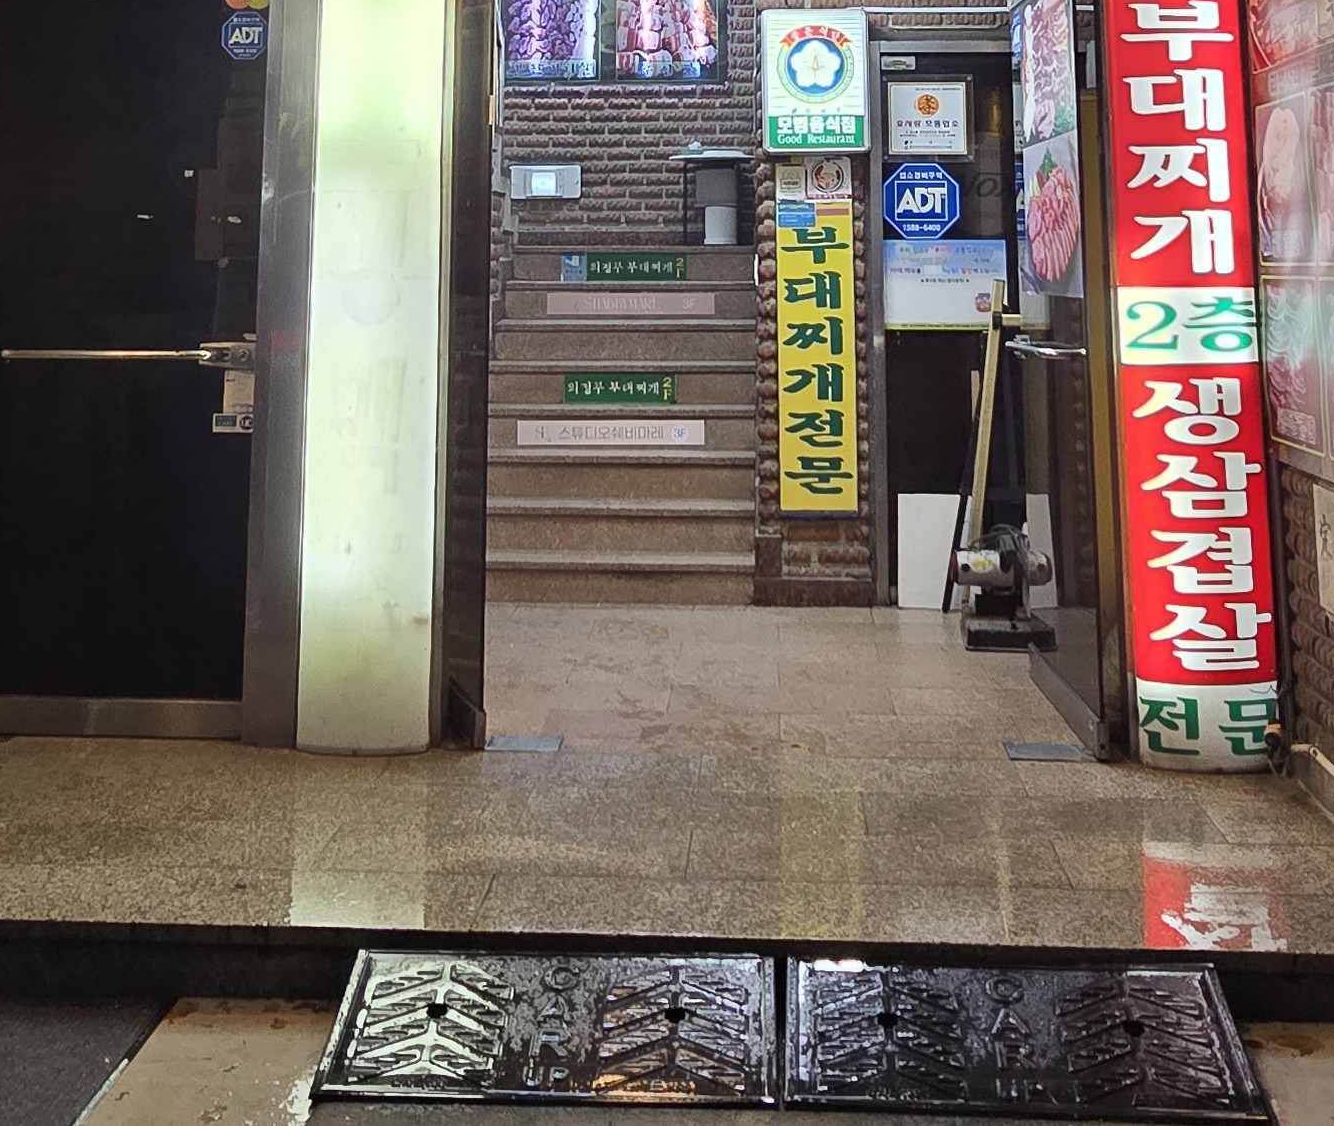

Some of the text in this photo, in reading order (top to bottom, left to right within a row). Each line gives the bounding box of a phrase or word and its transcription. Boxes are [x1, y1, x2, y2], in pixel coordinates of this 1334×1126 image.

[228, 26, 263, 45] ADT
[777, 116, 856, 134] 모범음식점
[777, 134, 855, 144] Good Restaurant
[1120, 0, 1235, 275] 부대찌개
[896, 186, 948, 214] ADT
[1126, 297, 1257, 353] 2층
[1132, 377, 1272, 671] 생삼겹살
[1139, 695, 1279, 758] 전문
